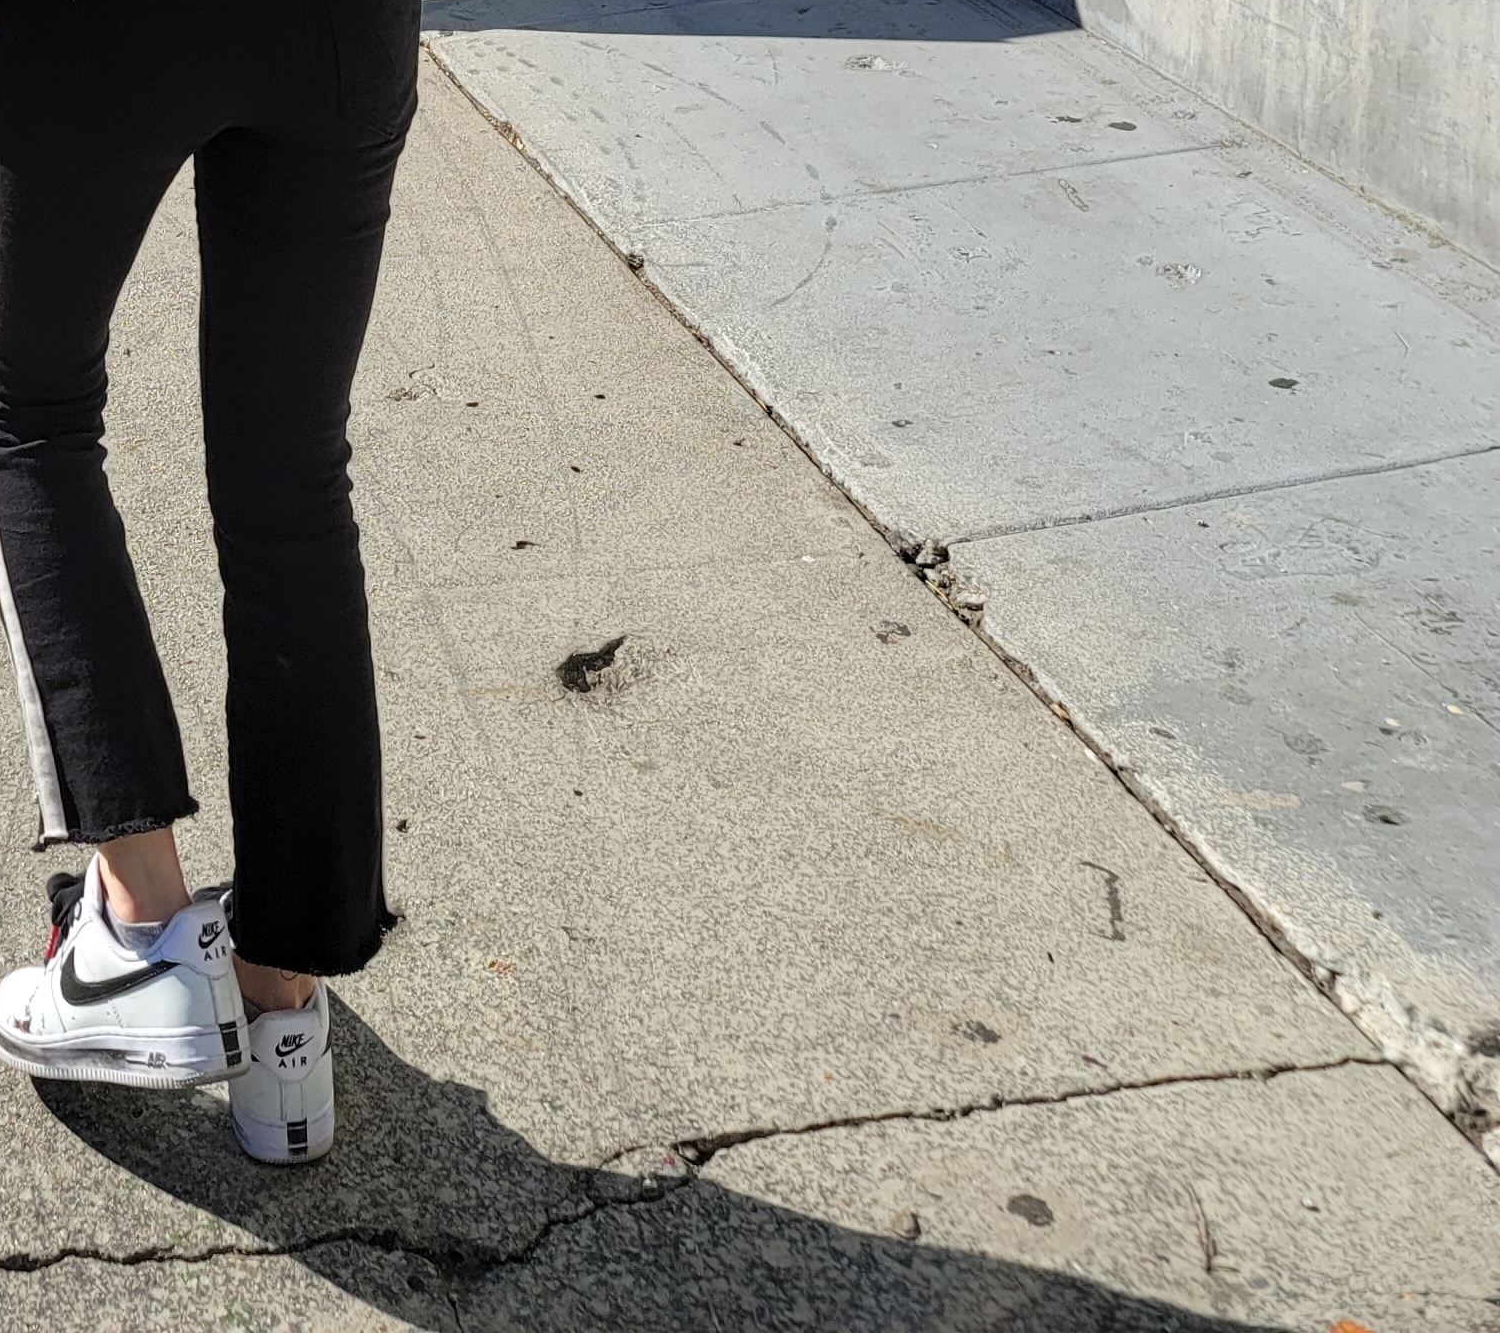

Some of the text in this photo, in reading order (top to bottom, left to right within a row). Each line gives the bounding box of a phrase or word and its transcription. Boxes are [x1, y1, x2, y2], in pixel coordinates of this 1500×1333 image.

[202, 920, 220, 938] NIKE
[204, 945, 228, 961] AIR
[281, 1033, 305, 1048] NIKE
[278, 1056, 308, 1068] AIR
